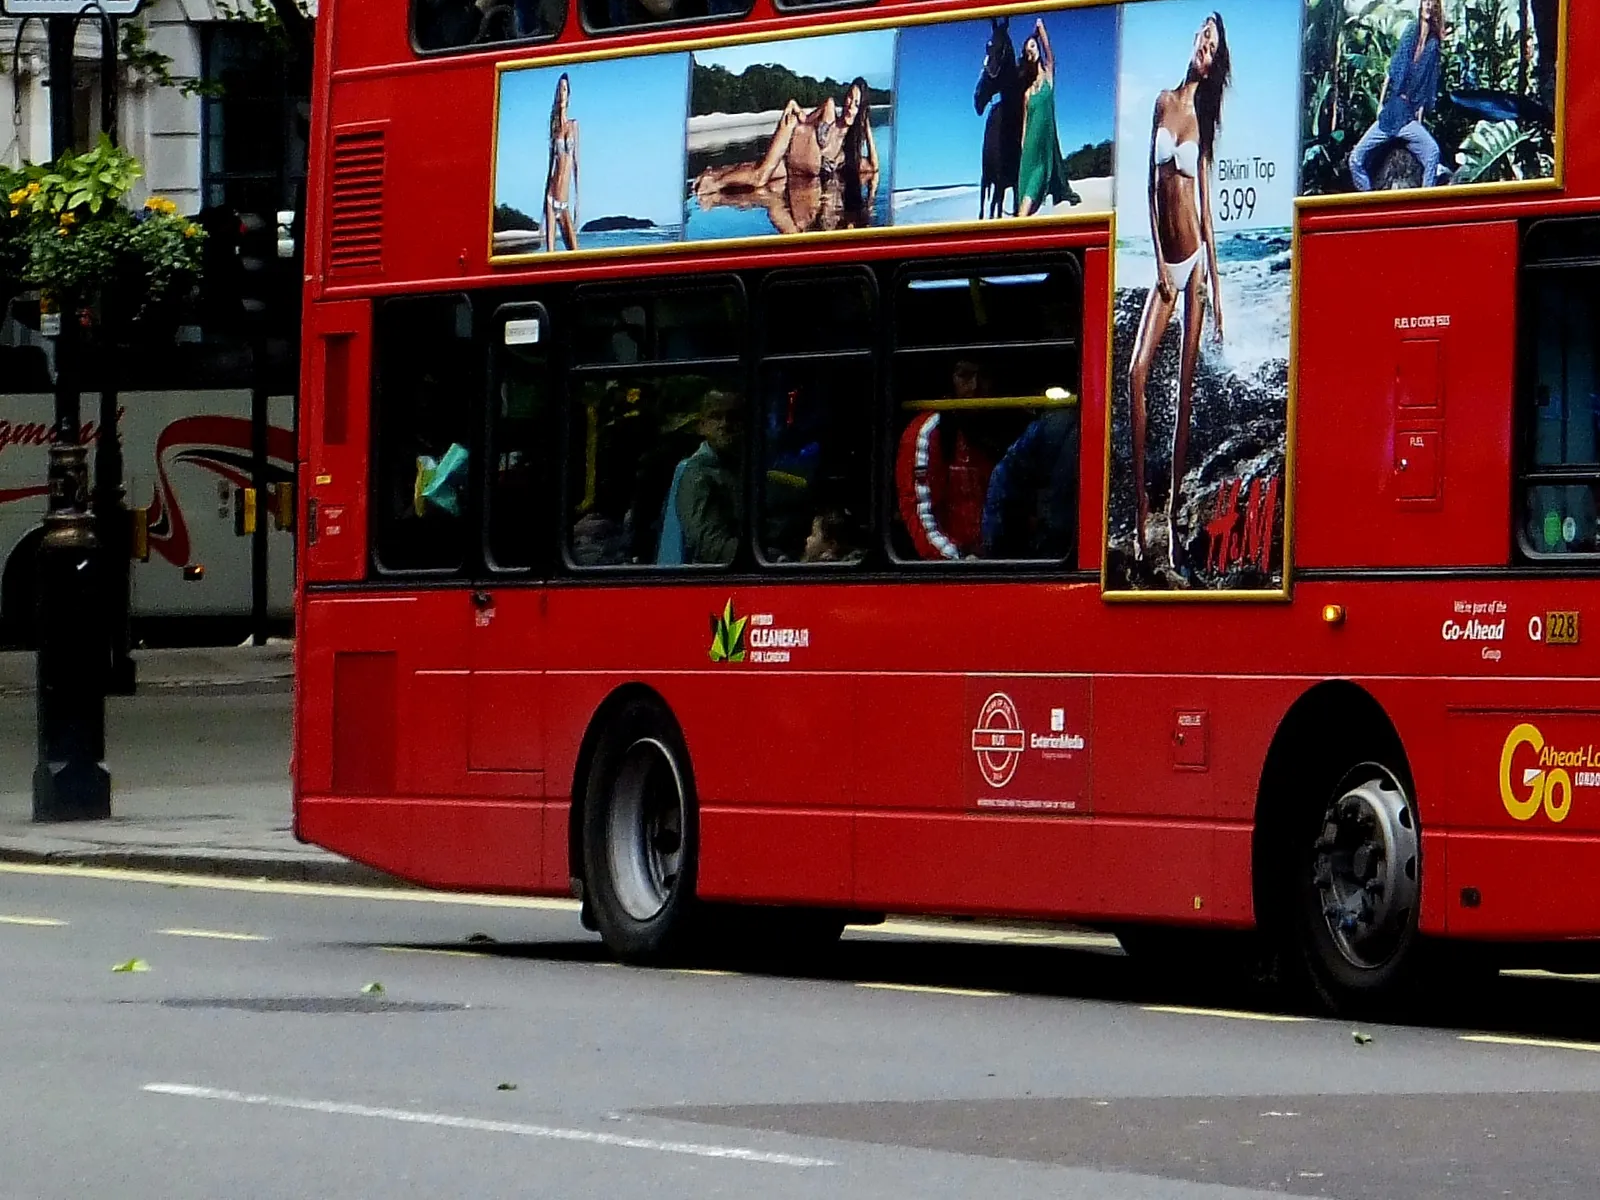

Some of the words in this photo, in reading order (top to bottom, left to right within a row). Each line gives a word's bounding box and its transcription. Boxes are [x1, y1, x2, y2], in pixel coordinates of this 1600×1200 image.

[1219, 158, 1250, 181] Bikini
[1252, 156, 1276, 184] Top
[1218, 186, 1257, 222] 3.99
[1204, 476, 1278, 575] H&M
[1441, 618, 1506, 641] Go-Ahead
[1528, 615, 1543, 641] Q
[1549, 613, 1576, 639] 228
[1500, 723, 1572, 823] Go
